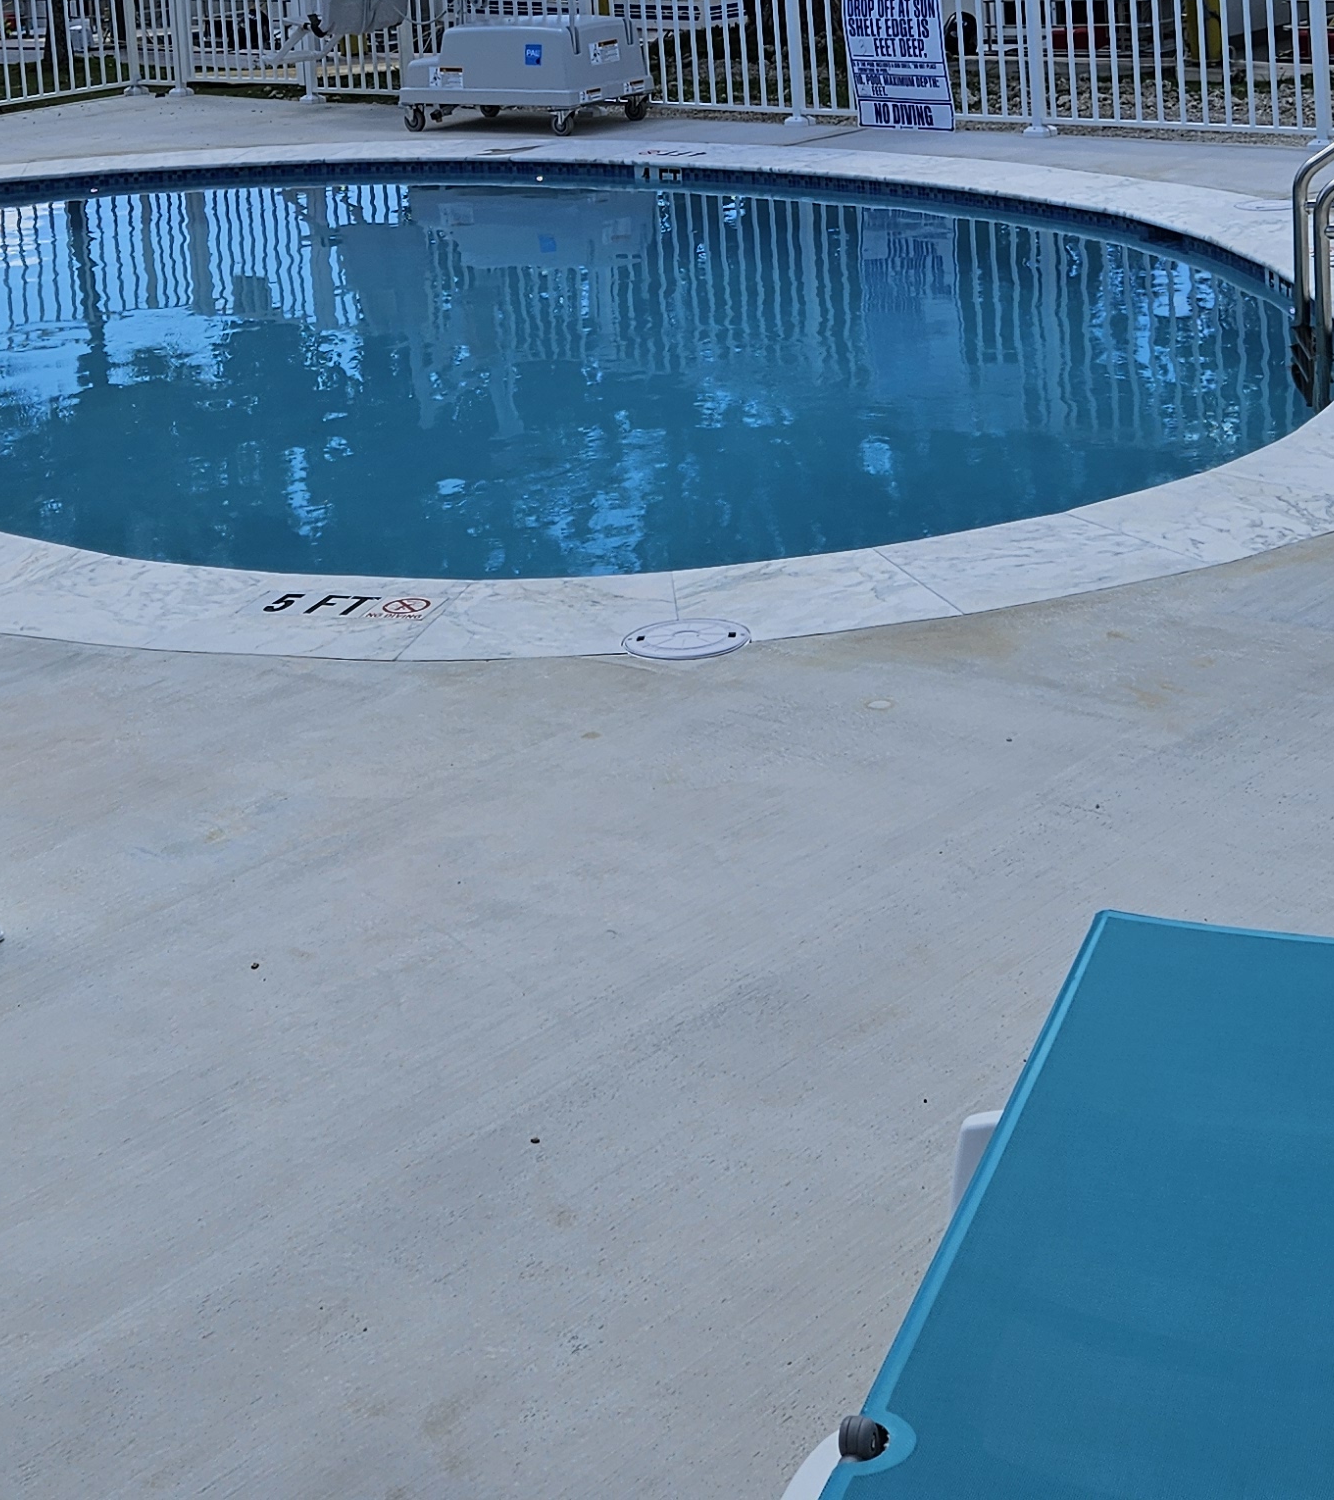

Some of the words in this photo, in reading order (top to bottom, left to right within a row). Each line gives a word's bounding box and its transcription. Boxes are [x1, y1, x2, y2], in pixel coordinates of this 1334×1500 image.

[848, 18, 881, 37] SHELF
[885, 18, 914, 38] EDGE
[917, 18, 929, 38] IS
[874, 38, 897, 57] FEET
[899, 38, 927, 58] DEEP.
[874, 103, 890, 124] NO
[892, 104, 934, 126] DIVING
[263, 594, 306, 612] 5
[303, 595, 382, 616] FT
